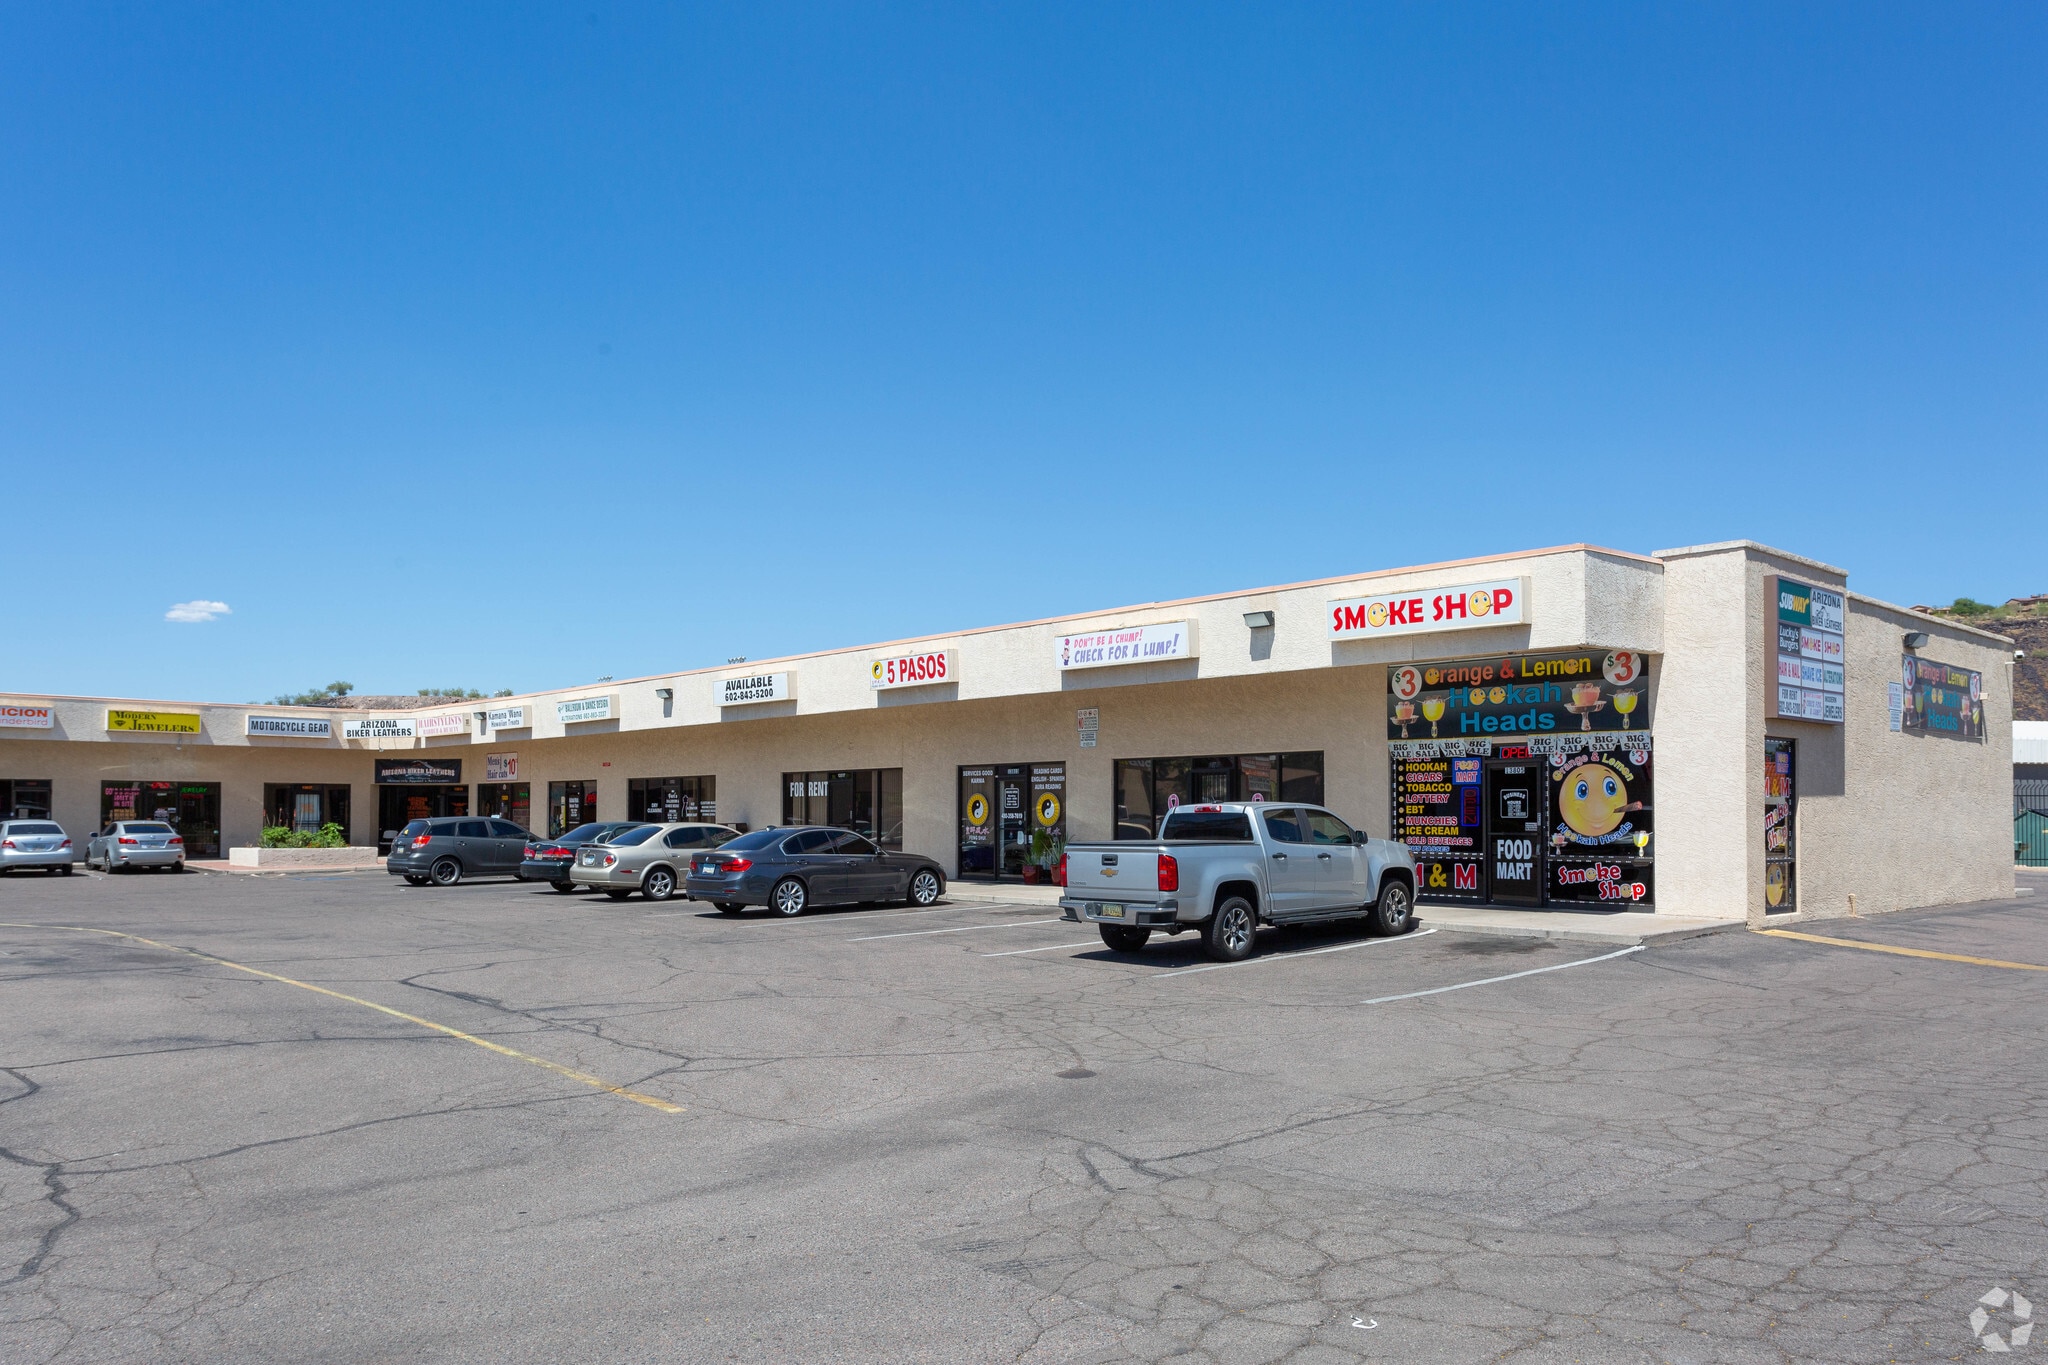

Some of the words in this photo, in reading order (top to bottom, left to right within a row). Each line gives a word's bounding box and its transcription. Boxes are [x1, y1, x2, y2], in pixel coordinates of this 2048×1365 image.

[1779, 592, 1809, 614] SUBWAY
[1812, 590, 1841, 609] ARIZONA
[1333, 598, 1424, 632] SMOKE
[1432, 588, 1513, 622] SHOP
[1812, 615, 1823, 627] BIKER
[1823, 618, 1842, 631] LEATHERS
[1073, 636, 1095, 648] DON'T
[1096, 636, 1105, 646] BE
[1108, 635, 1113, 644] A
[1115, 629, 1143, 643] CHUMP!
[1780, 625, 1799, 641] Lucky's
[1074, 647, 1104, 663] CHECK
[1108, 644, 1128, 660] FOR
[1132, 643, 1139, 658] A
[1143, 633, 1180, 657] LUMP!
[1780, 637, 1799, 652] Burgers
[887, 660, 895, 684] 5
[899, 653, 946, 682] PASOS
[1424, 665, 1494, 686] Orange
[1500, 659, 1515, 679] &
[1521, 657, 1591, 677] Lemon
[1607, 651, 1633, 682] $3
[1917, 661, 1940, 685] Orange
[1947, 666, 1968, 687] Lemon
[725, 675, 773, 691] AVAILABLE
[1395, 669, 1416, 697] $3
[725, 688, 774, 701] 602-843-5200
[1449, 681, 1562, 708] Hookah
[0, 718, 48, 726] nderbird
[115, 711, 157, 720] MODERN
[488, 711, 507, 720] Kamana
[1460, 708, 1556, 733] Heads
[1928, 708, 1958, 731] Heads
[129, 720, 194, 732] JEWELERS
[251, 720, 305, 732] MOTORCYCLE
[308, 723, 329, 733] GEAR
[360, 720, 398, 729] ARIZONA
[418, 716, 463, 729] HAIRSTYLISTS
[346, 729, 370, 738] BIKER
[373, 728, 412, 737] LEATHERS
[1594, 735, 1613, 743] BIG
[1626, 734, 1644, 742] BIG
[1469, 740, 1486, 748] BIG
[1533, 738, 1551, 746] BIG
[1564, 736, 1582, 744] BIG
[1624, 742, 1650, 750] SALE
[1393, 743, 1408, 751] BIG
[1415, 749, 1439, 758] SALE
[1530, 746, 1554, 754] SALE
[1391, 750, 1412, 758] SALE
[1406, 762, 1447, 772] HOOKAH
[1552, 754, 1589, 781] Orange
[1590, 751, 1600, 761] &
[1601, 753, 1634, 782] Lemon
[487, 769, 498, 779] Hair
[498, 770, 508, 778] cuts
[1406, 772, 1443, 782] CIGARS
[1456, 771, 1478, 783] MART
[790, 782, 804, 797] FOR
[808, 781, 828, 797] RENT
[1406, 783, 1452, 792] TOBACCO
[1771, 778, 1779, 797] &
[1780, 777, 1790, 798] M
[1406, 794, 1450, 803] LOTTERY
[1406, 805, 1424, 814] EBT
[1406, 816, 1458, 826] MUNCHIES
[1406, 826, 1422, 835] ICE
[1424, 826, 1459, 835] CREAM
[1556, 823, 1598, 846] Hookah
[1599, 821, 1633, 846] Heads
[1406, 836, 1426, 845] COLD
[1427, 837, 1473, 846] BEVERAGES
[1496, 839, 1531, 860] FOOD
[1429, 863, 1447, 887] &
[1454, 863, 1477, 889] M
[1496, 862, 1533, 881] MART
[1558, 862, 1621, 886] Smoke
[1598, 880, 1646, 900] Shop
